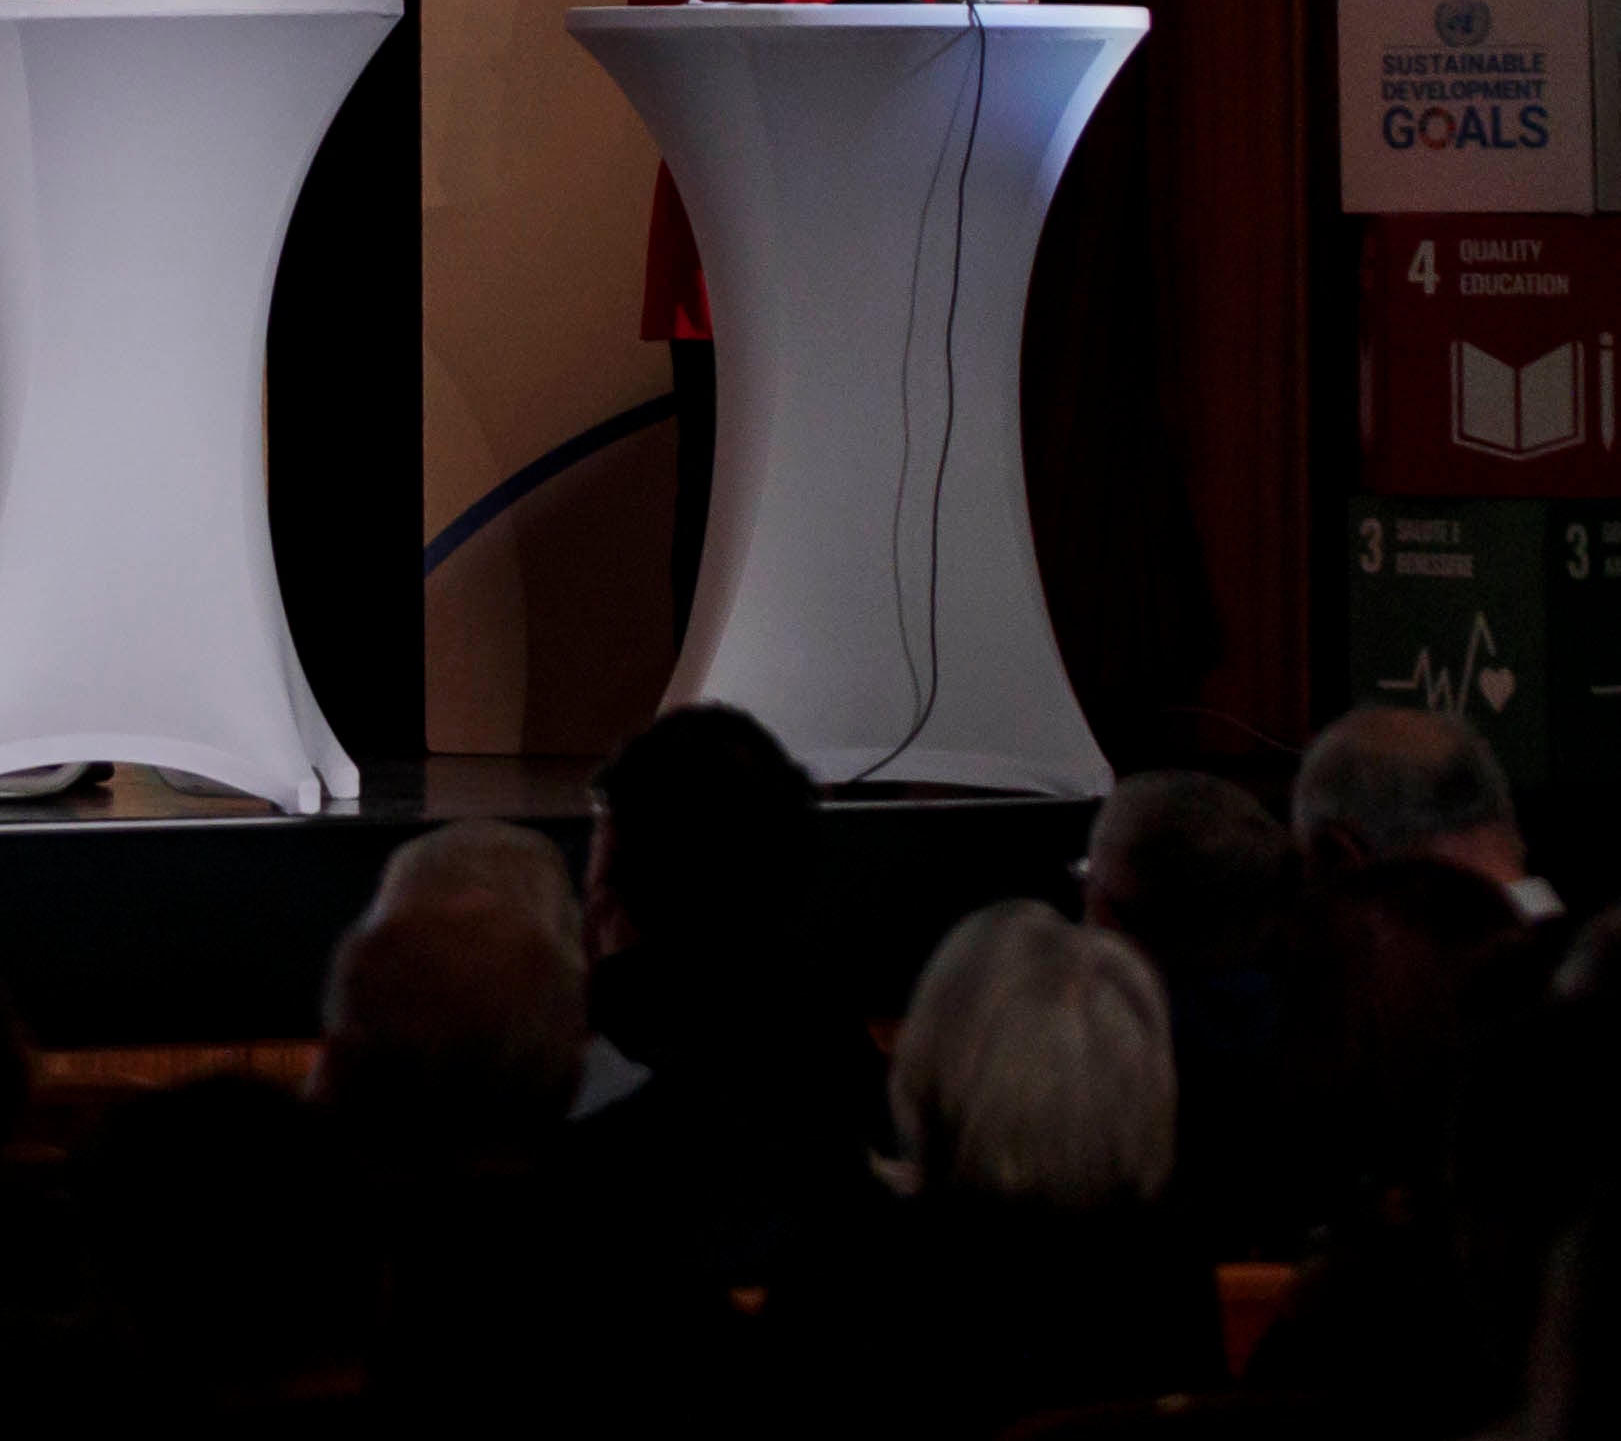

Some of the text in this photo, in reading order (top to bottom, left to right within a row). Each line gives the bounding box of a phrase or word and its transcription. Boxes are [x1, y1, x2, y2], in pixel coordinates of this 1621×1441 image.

[1382, 53, 1546, 75] SUSTAINABLE
[1381, 79, 1546, 100] DEVELOPMENT
[1382, 105, 1548, 150] GOALS
[1406, 239, 1440, 296] 4
[1459, 238, 1544, 263] QUALITY
[1458, 272, 1570, 296] EDUCATION
[1359, 518, 1384, 574] 3
[1565, 522, 1591, 581] 3
